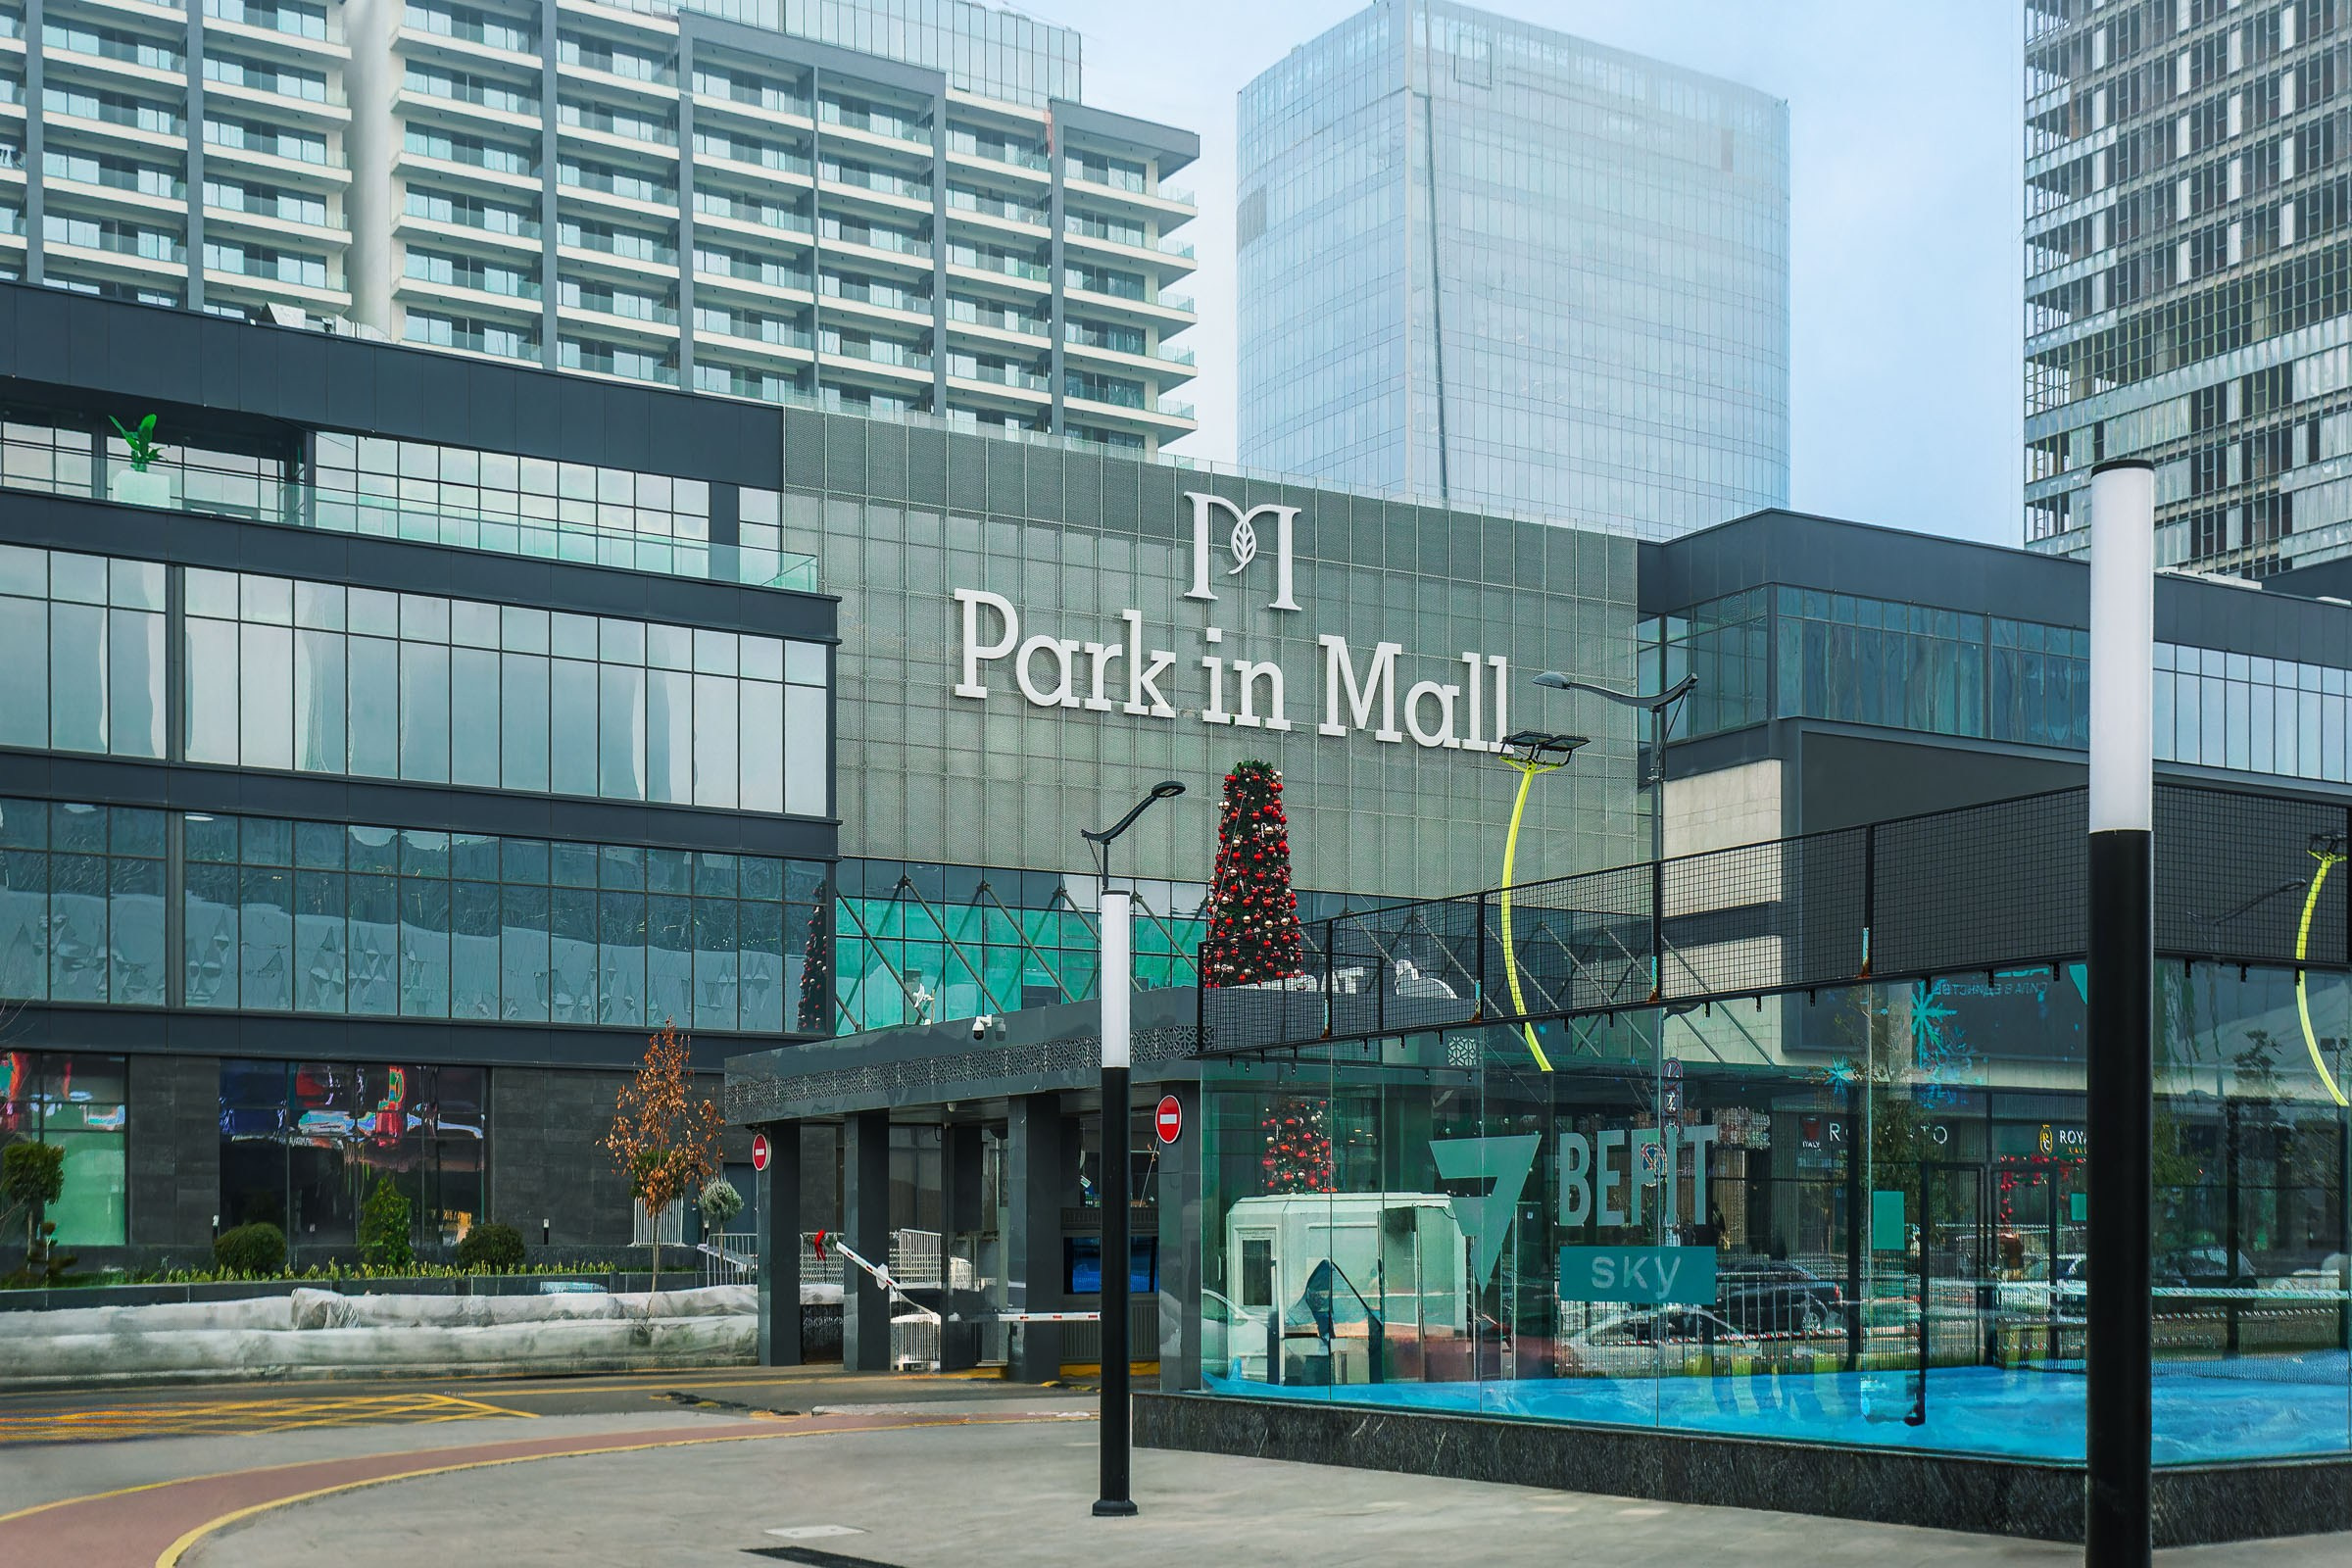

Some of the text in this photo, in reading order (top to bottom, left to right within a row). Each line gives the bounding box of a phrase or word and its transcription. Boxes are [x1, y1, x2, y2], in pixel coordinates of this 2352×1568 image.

[955, 588, 1514, 755] Park in Mall
[1559, 1125, 1718, 1227] BEFIT
